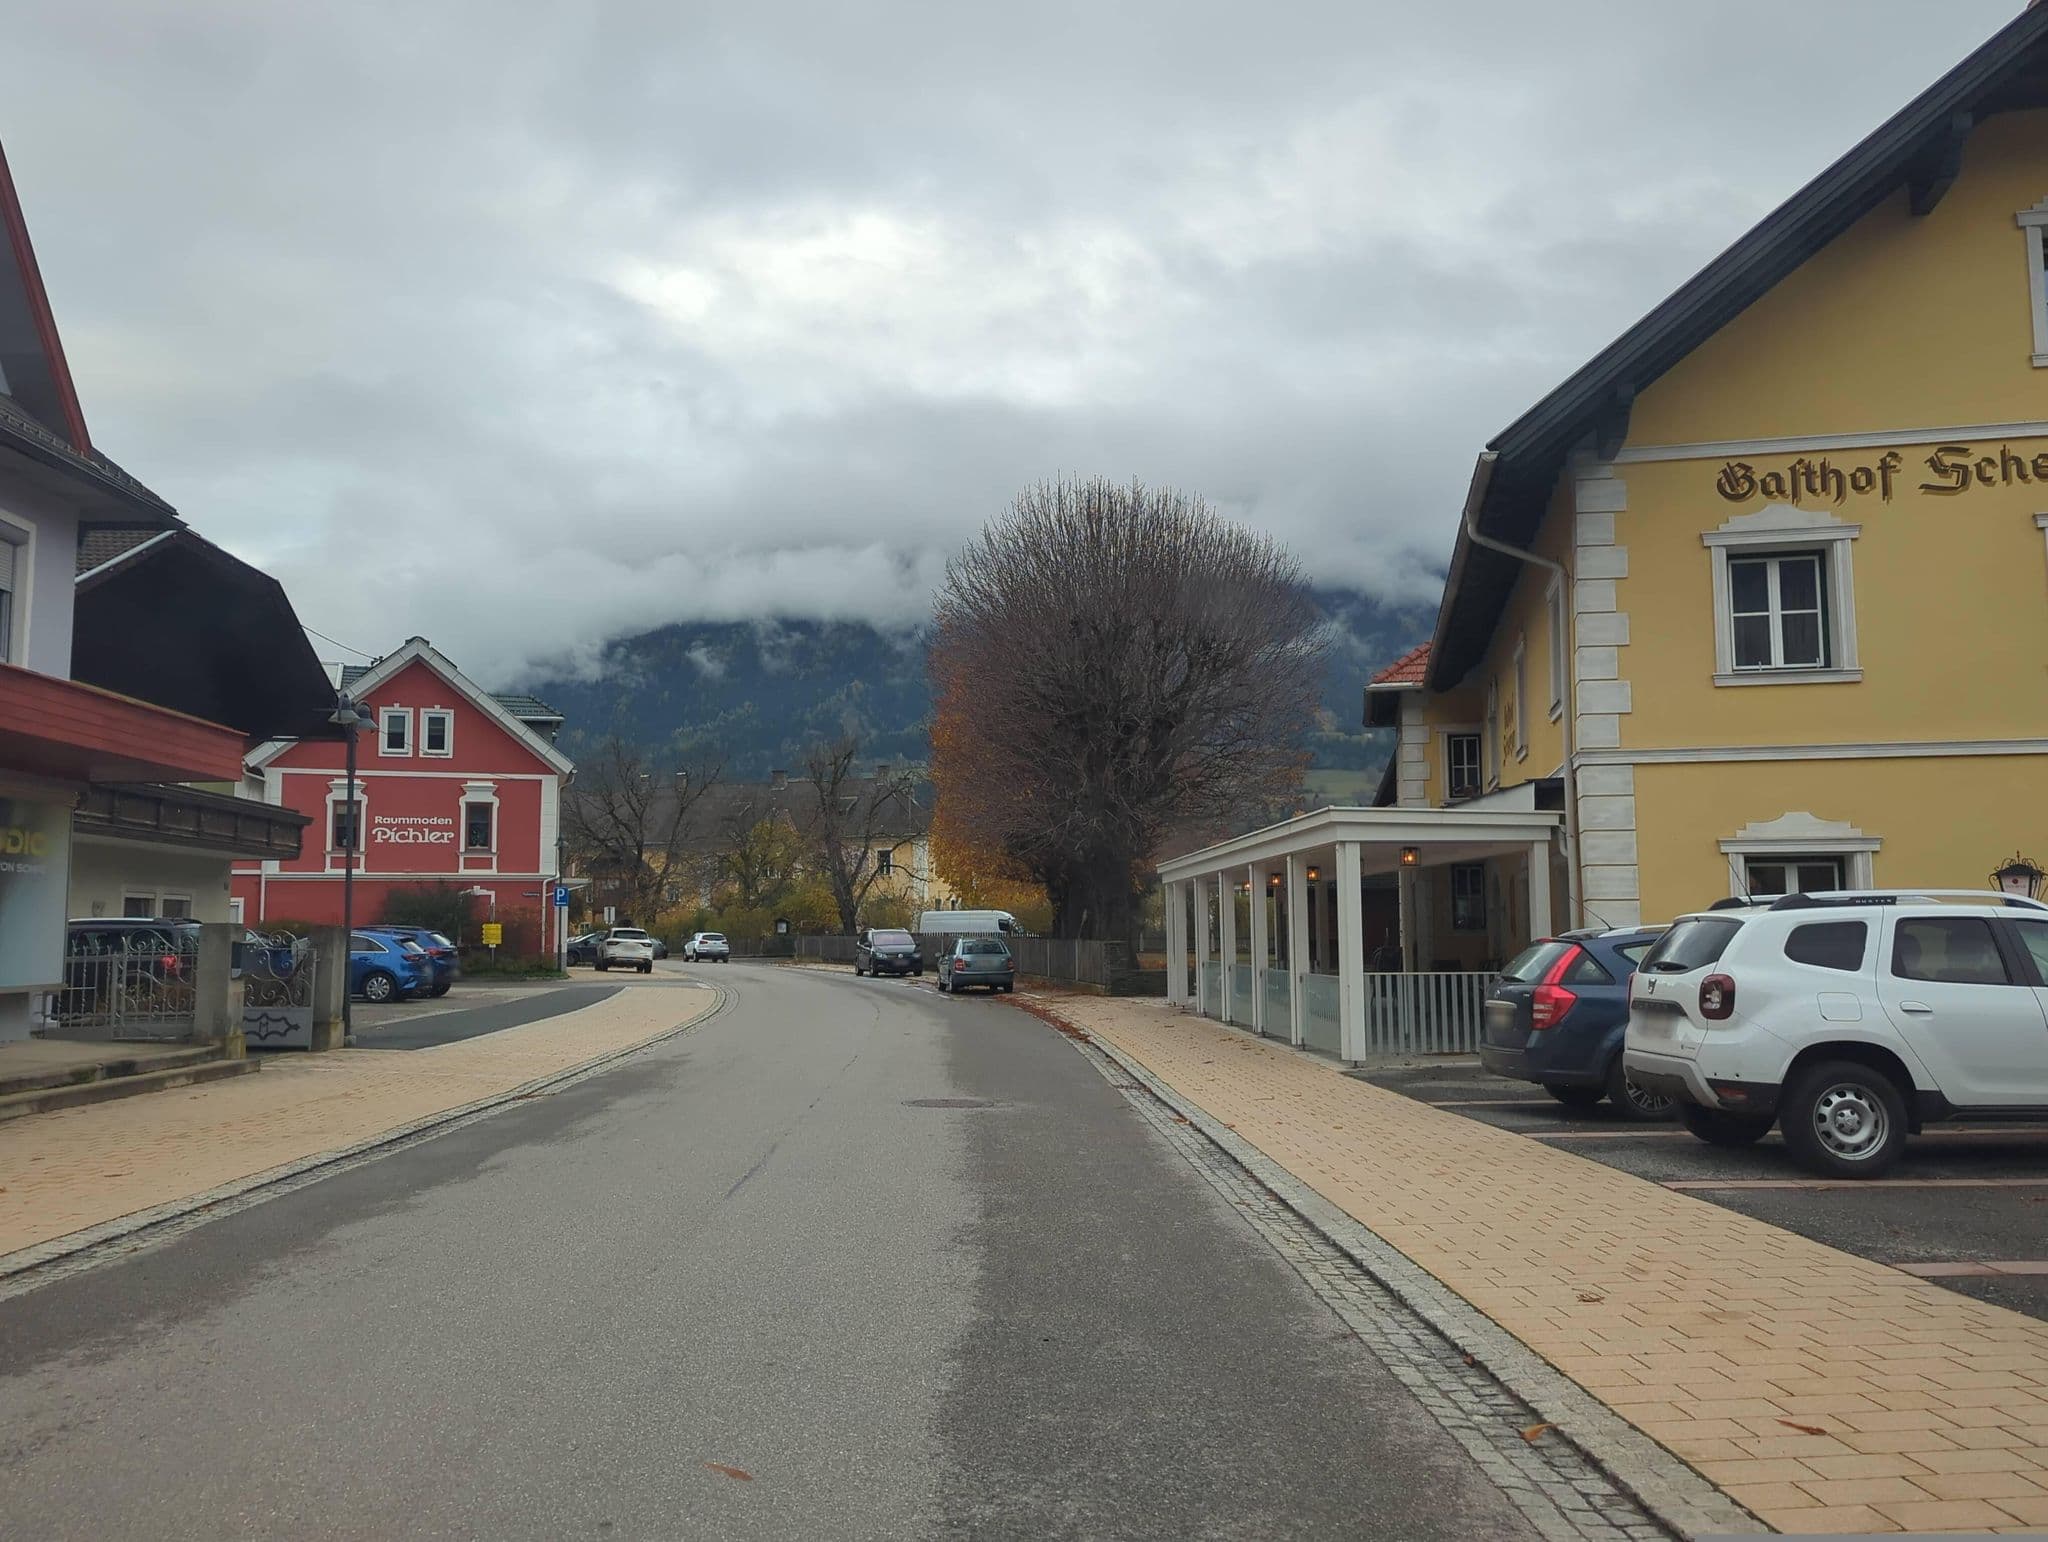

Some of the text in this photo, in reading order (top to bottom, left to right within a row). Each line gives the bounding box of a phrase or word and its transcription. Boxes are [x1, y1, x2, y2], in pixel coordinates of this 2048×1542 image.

[1918, 445, 2048, 491] Sche
[374, 815, 453, 825] Raummoden
[371, 826, 455, 844] Pichler
[556, 888, 566, 902] P
